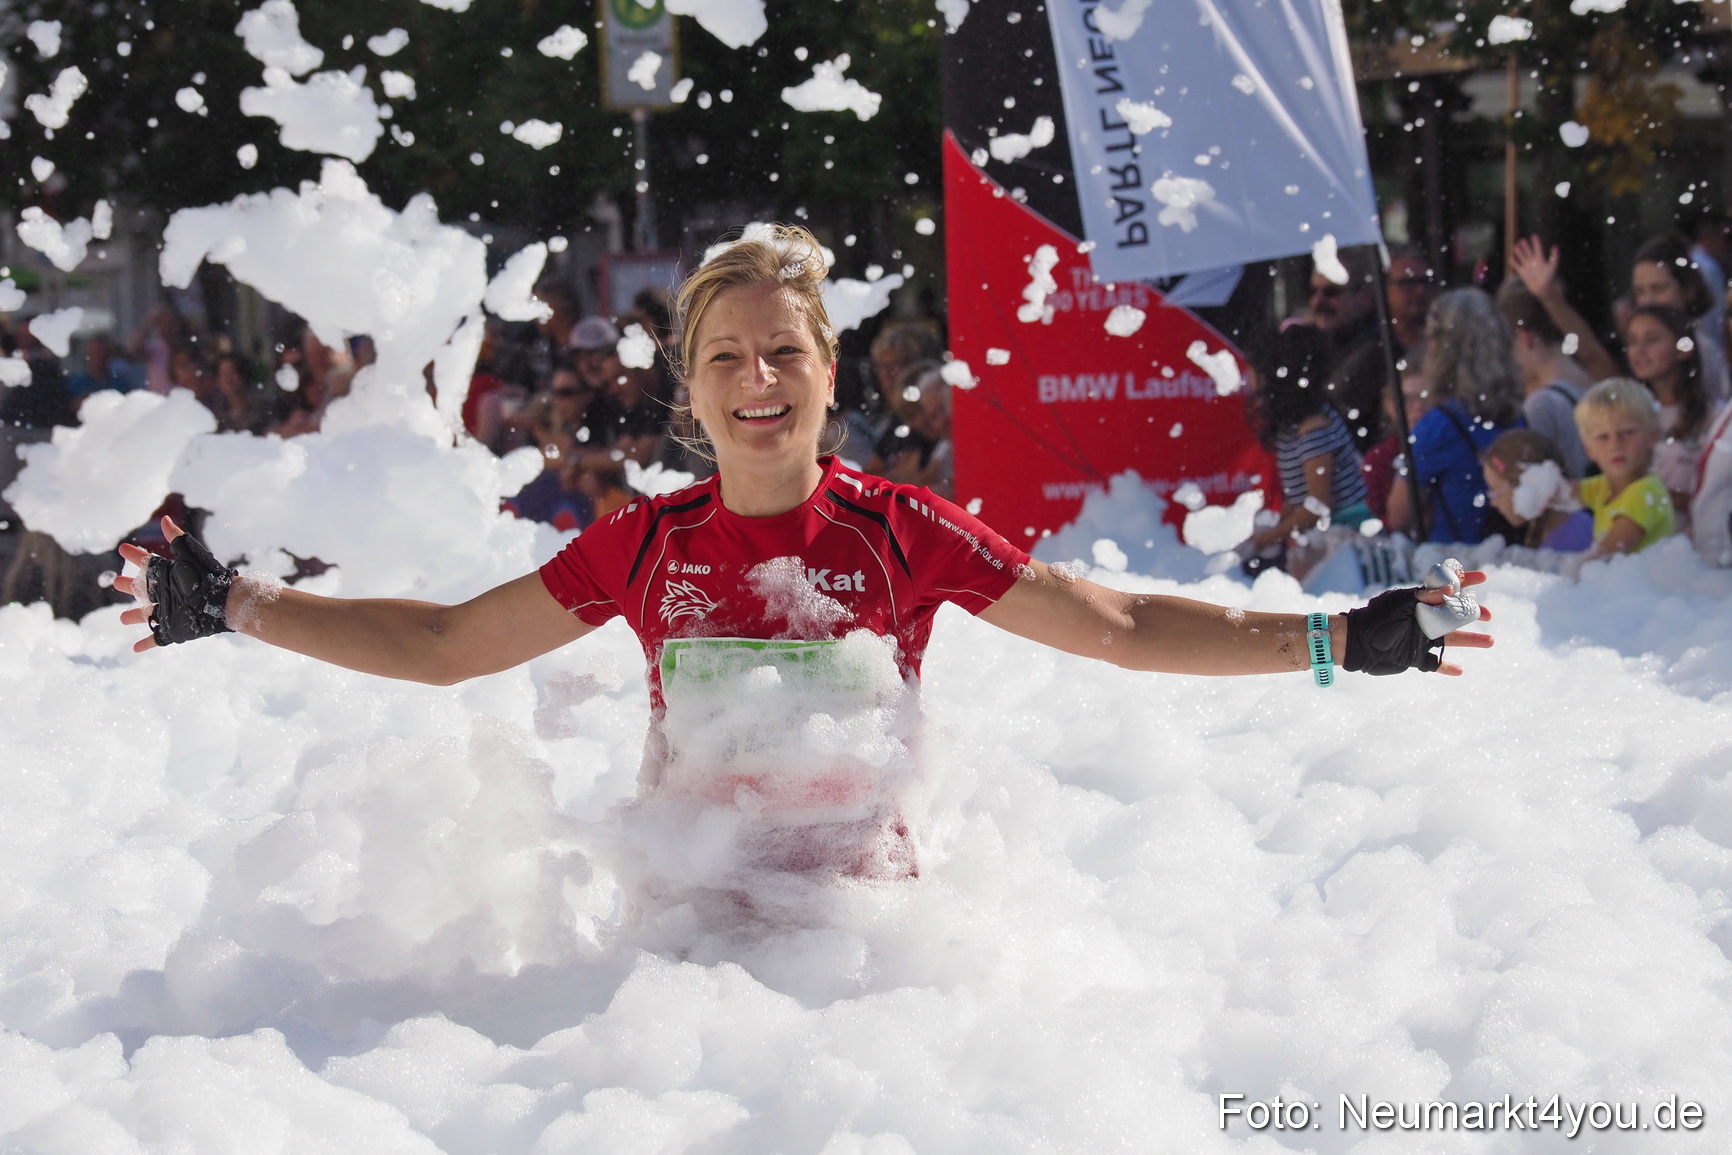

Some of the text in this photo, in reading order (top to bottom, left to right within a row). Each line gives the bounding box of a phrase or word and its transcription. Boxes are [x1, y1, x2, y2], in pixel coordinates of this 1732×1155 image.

[1075, 286, 1149, 311] YEARS
[1038, 372, 1118, 403] BMW
[681, 562, 711, 575] JAKO
[808, 568, 866, 592] Kat
